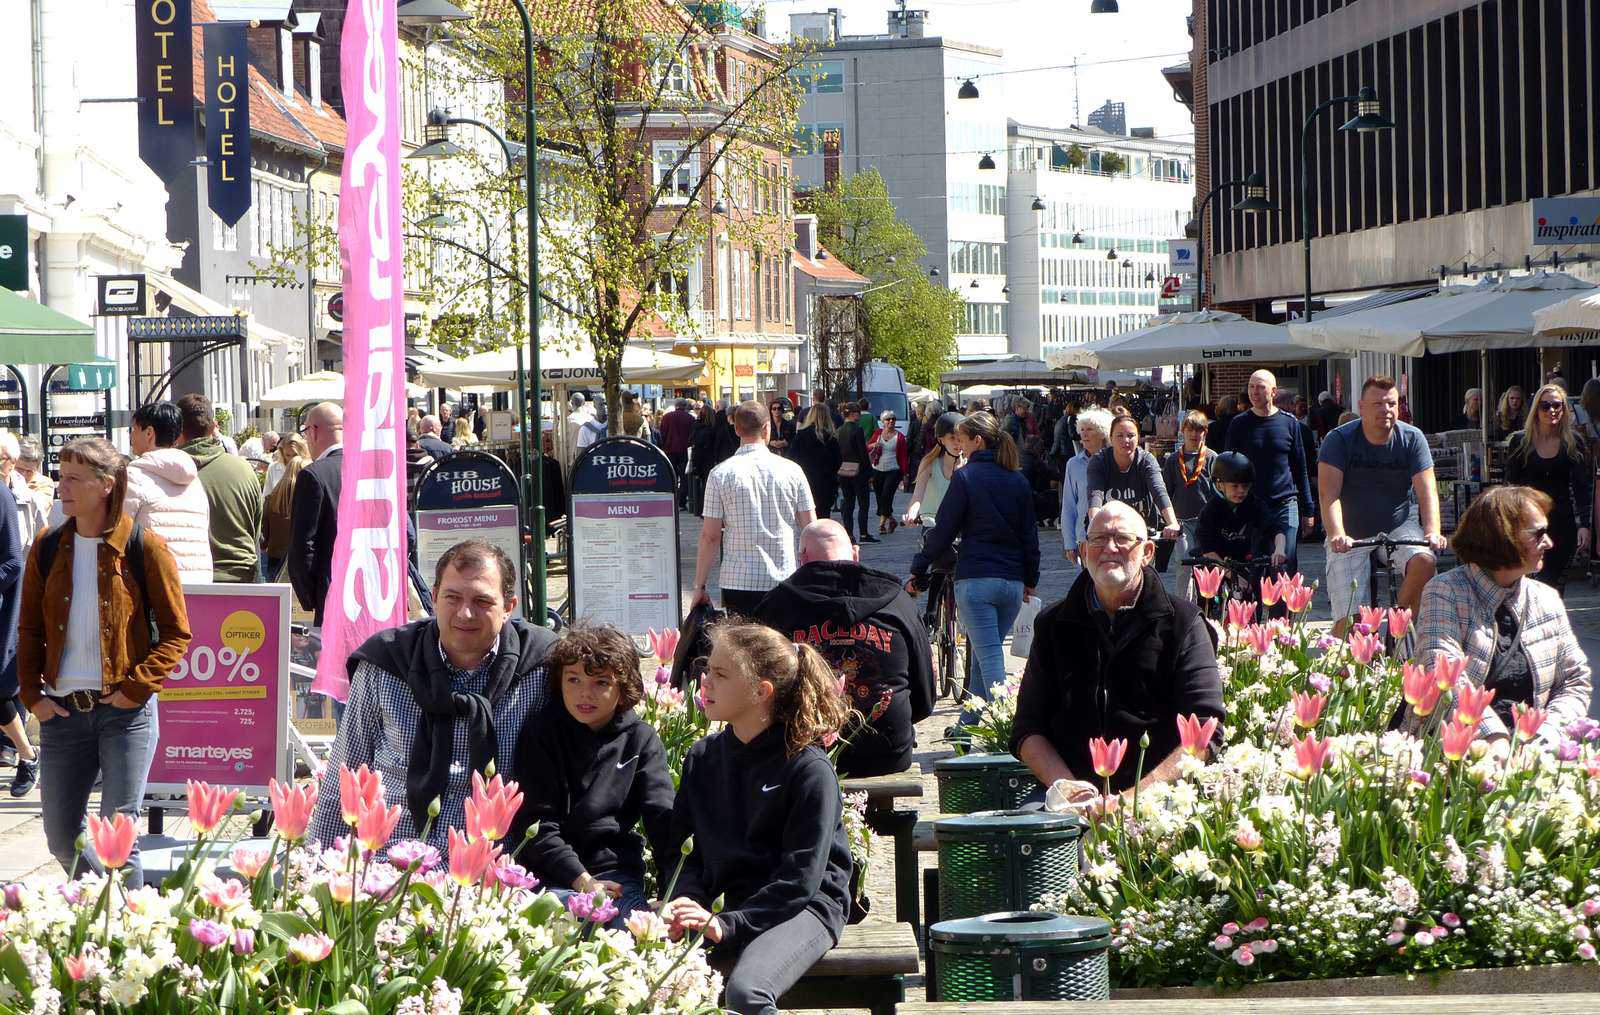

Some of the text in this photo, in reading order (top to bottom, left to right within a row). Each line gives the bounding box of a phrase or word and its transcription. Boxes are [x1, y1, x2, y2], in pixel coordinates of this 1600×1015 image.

[217, 55, 237, 182] HOTEL
[1202, 348, 1253, 358] bahne
[592, 455, 635, 465] RIB
[435, 470, 479, 482] RIB
[607, 464, 658, 479] HOUSE
[451, 477, 502, 494] HOUSE
[607, 505, 640, 514] MENU
[437, 516, 473, 525] FROKOST
[474, 514, 498, 522] MENU
[225, 631, 260, 639] OPTIKER
[165, 745, 253, 762] smarteyes
